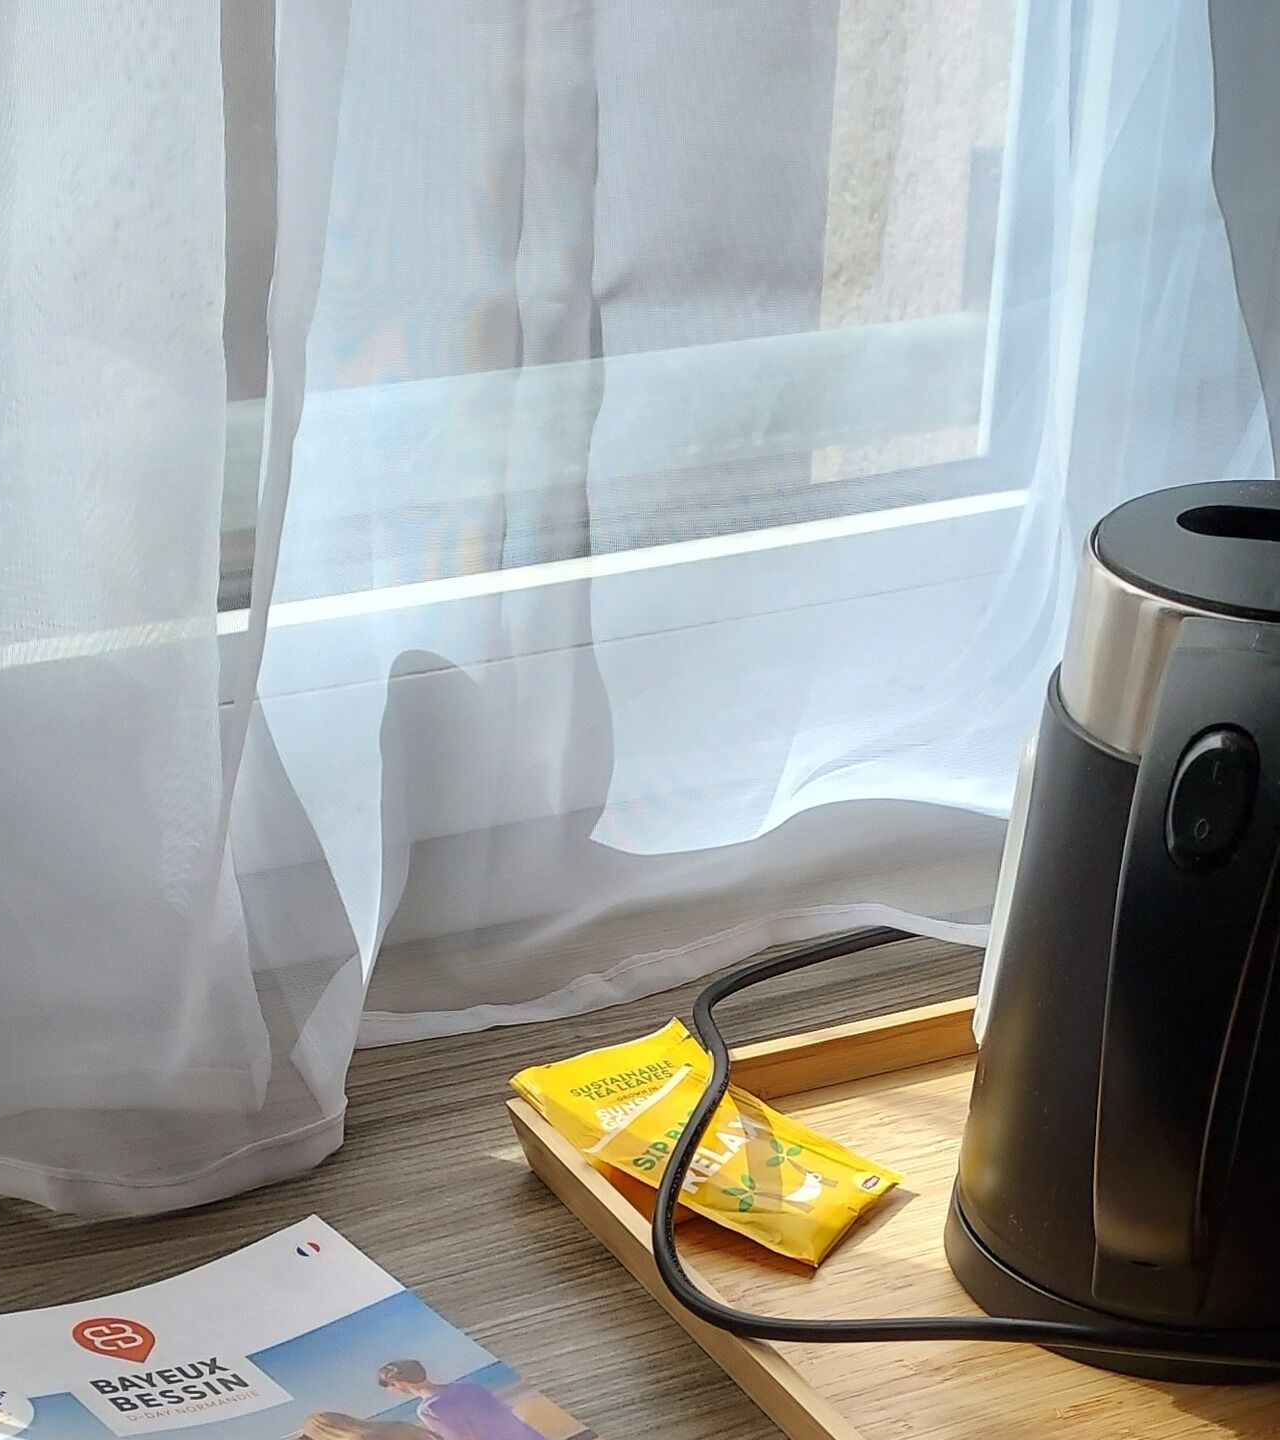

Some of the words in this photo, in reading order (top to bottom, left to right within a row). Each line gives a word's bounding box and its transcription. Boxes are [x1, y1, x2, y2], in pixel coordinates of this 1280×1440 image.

[570, 1060, 674, 1097] SUSTAINABLE
[584, 1088, 617, 1101] TEA
[617, 1070, 674, 1092] LEAVES
[633, 1141, 670, 1171] SIP
[683, 1113, 772, 1194] RELAX
[90, 1357, 230, 1394] BAYEUX
[108, 1374, 249, 1412] BESSIN
[126, 1407, 173, 1422] D-DAY
[174, 1390, 259, 1416] NORMANDIE
